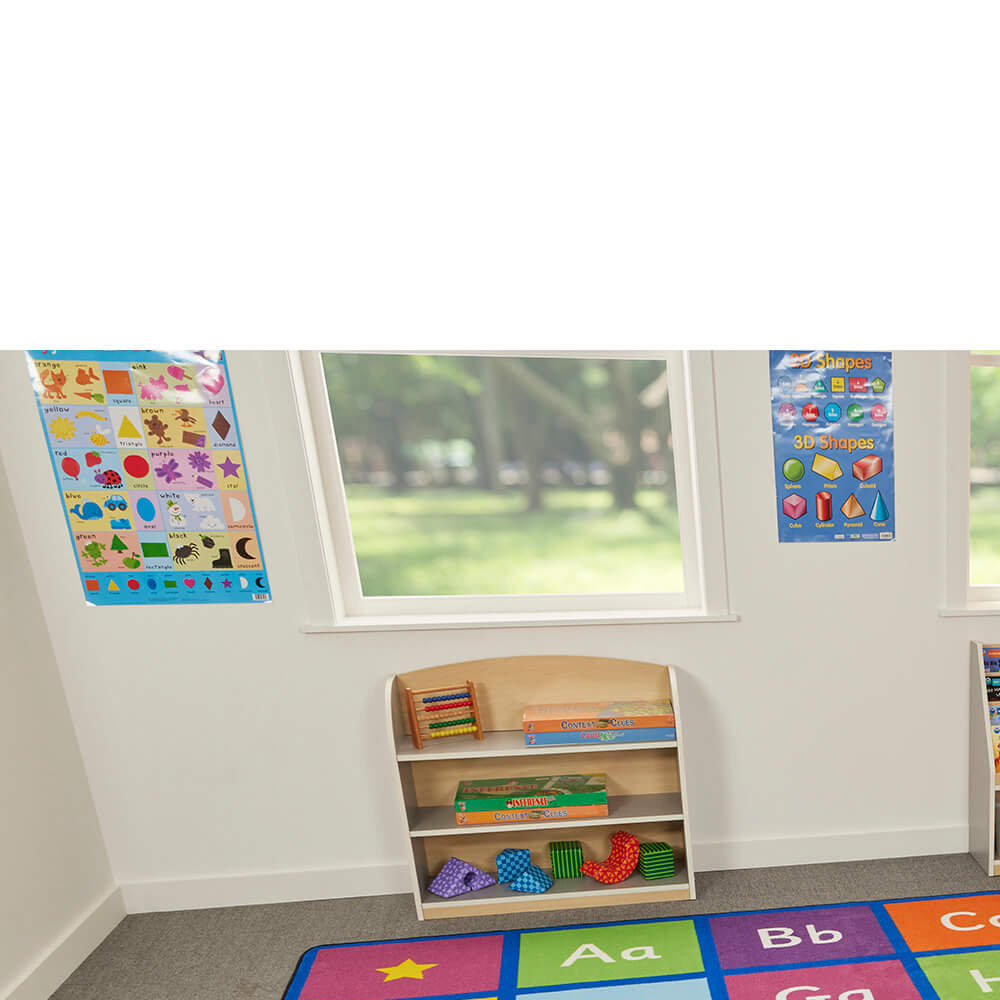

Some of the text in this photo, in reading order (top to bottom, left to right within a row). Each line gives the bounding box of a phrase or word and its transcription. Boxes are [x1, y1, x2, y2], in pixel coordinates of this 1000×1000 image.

[816, 352, 873, 373] Shapes
[793, 433, 875, 454] 3D Shapes
[610, 718, 636, 727] CLUES
[756, 924, 843, 949] Bb
[561, 943, 662, 967] Aa
